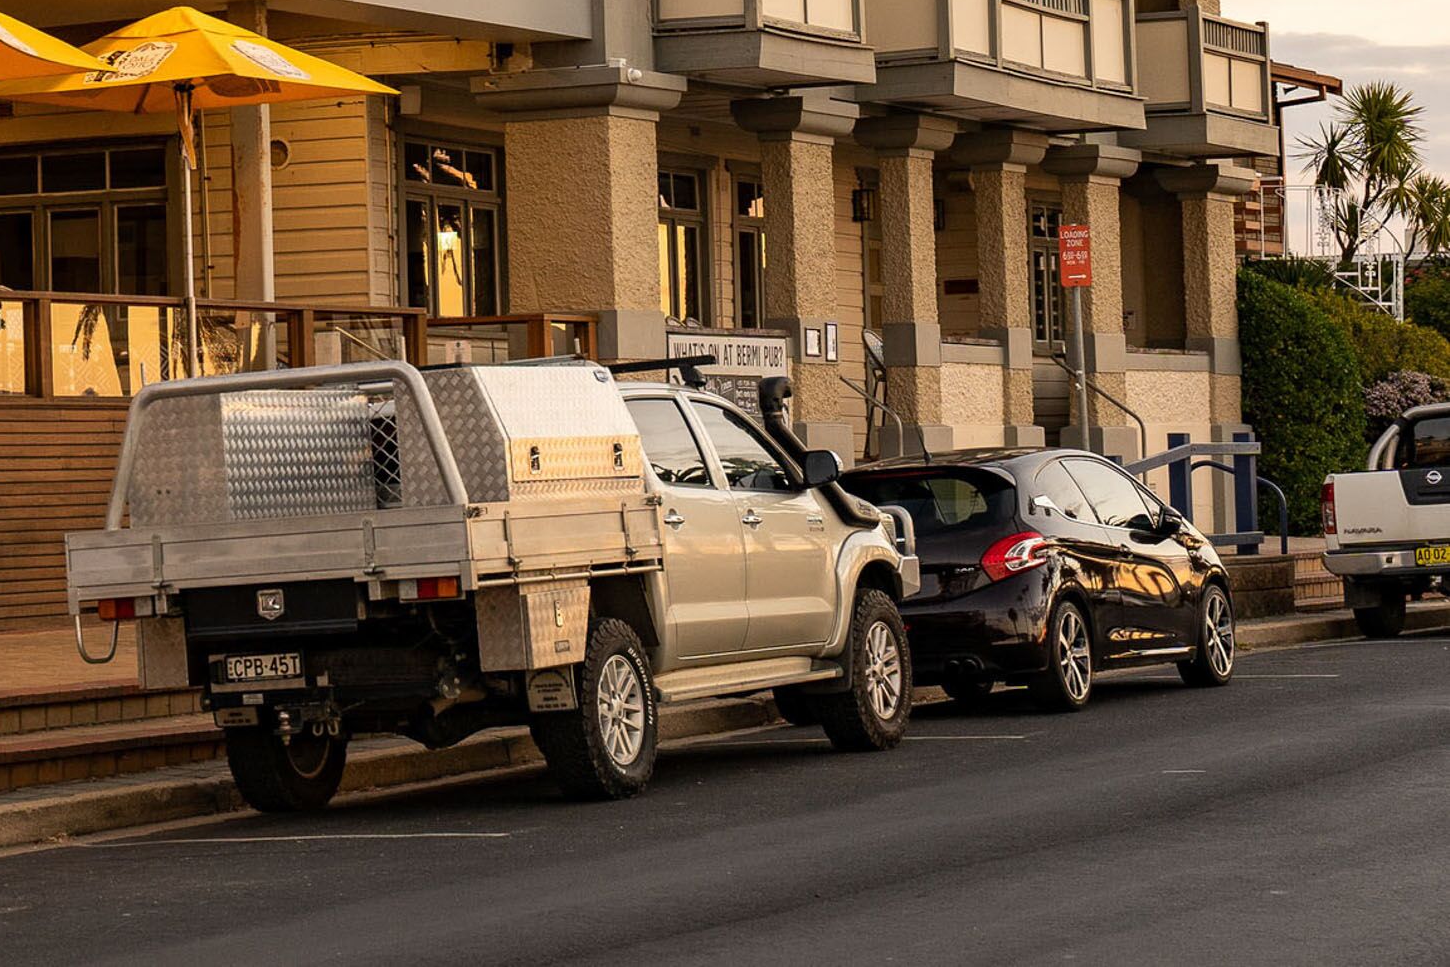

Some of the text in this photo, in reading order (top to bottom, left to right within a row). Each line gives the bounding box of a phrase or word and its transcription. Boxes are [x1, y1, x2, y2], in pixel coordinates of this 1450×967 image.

[1060, 230, 1088, 239] LOADING
[1066, 239, 1084, 247] ZONE
[673, 342, 705, 359] WHAT'S
[723, 343, 733, 363] AT
[737, 344, 761, 367] BERMI
[764, 346, 783, 368] PUB?
